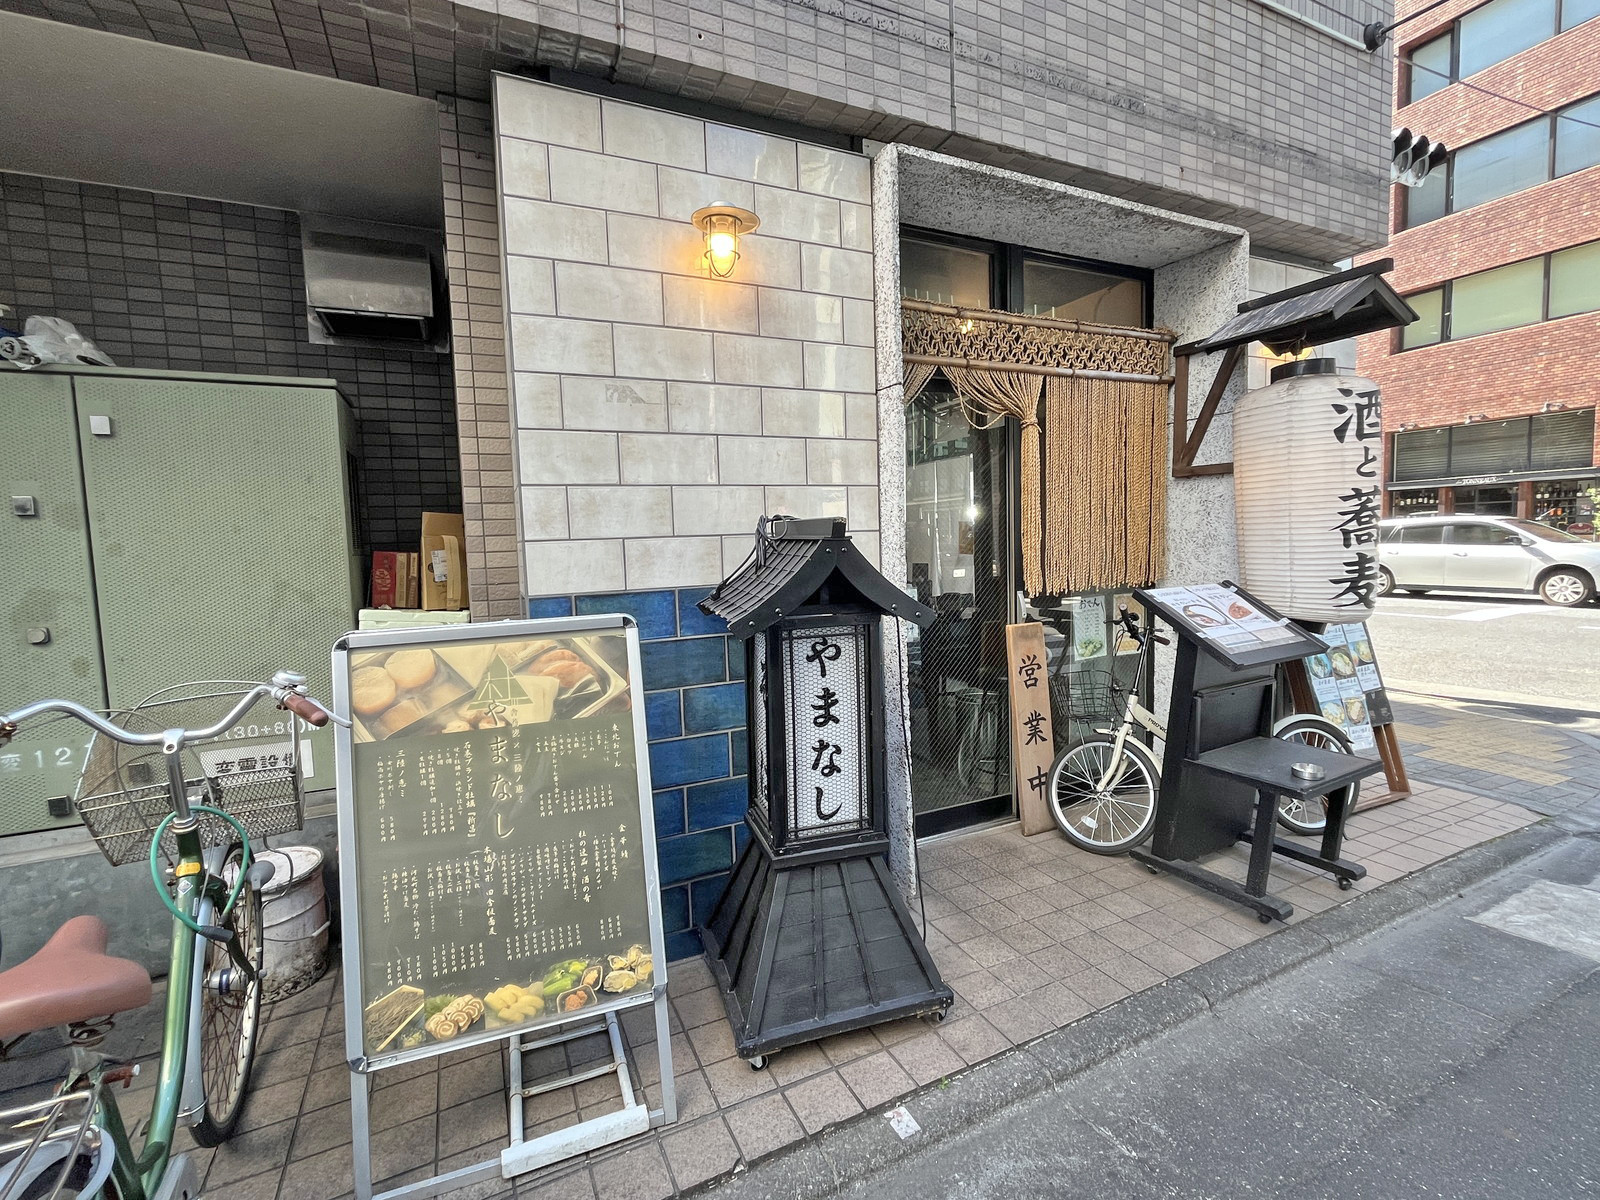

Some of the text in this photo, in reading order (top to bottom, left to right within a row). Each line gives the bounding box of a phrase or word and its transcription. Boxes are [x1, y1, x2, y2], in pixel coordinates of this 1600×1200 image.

[1328, 388, 1381, 609] 酒と蕎麦
[485, 699, 515, 838] やまなし
[611, 723, 622, 768] 東北おでん
[805, 637, 843, 821] やまなし
[1018, 654, 1048, 801] 営業中
[618, 823, 629, 859] 金華鯖
